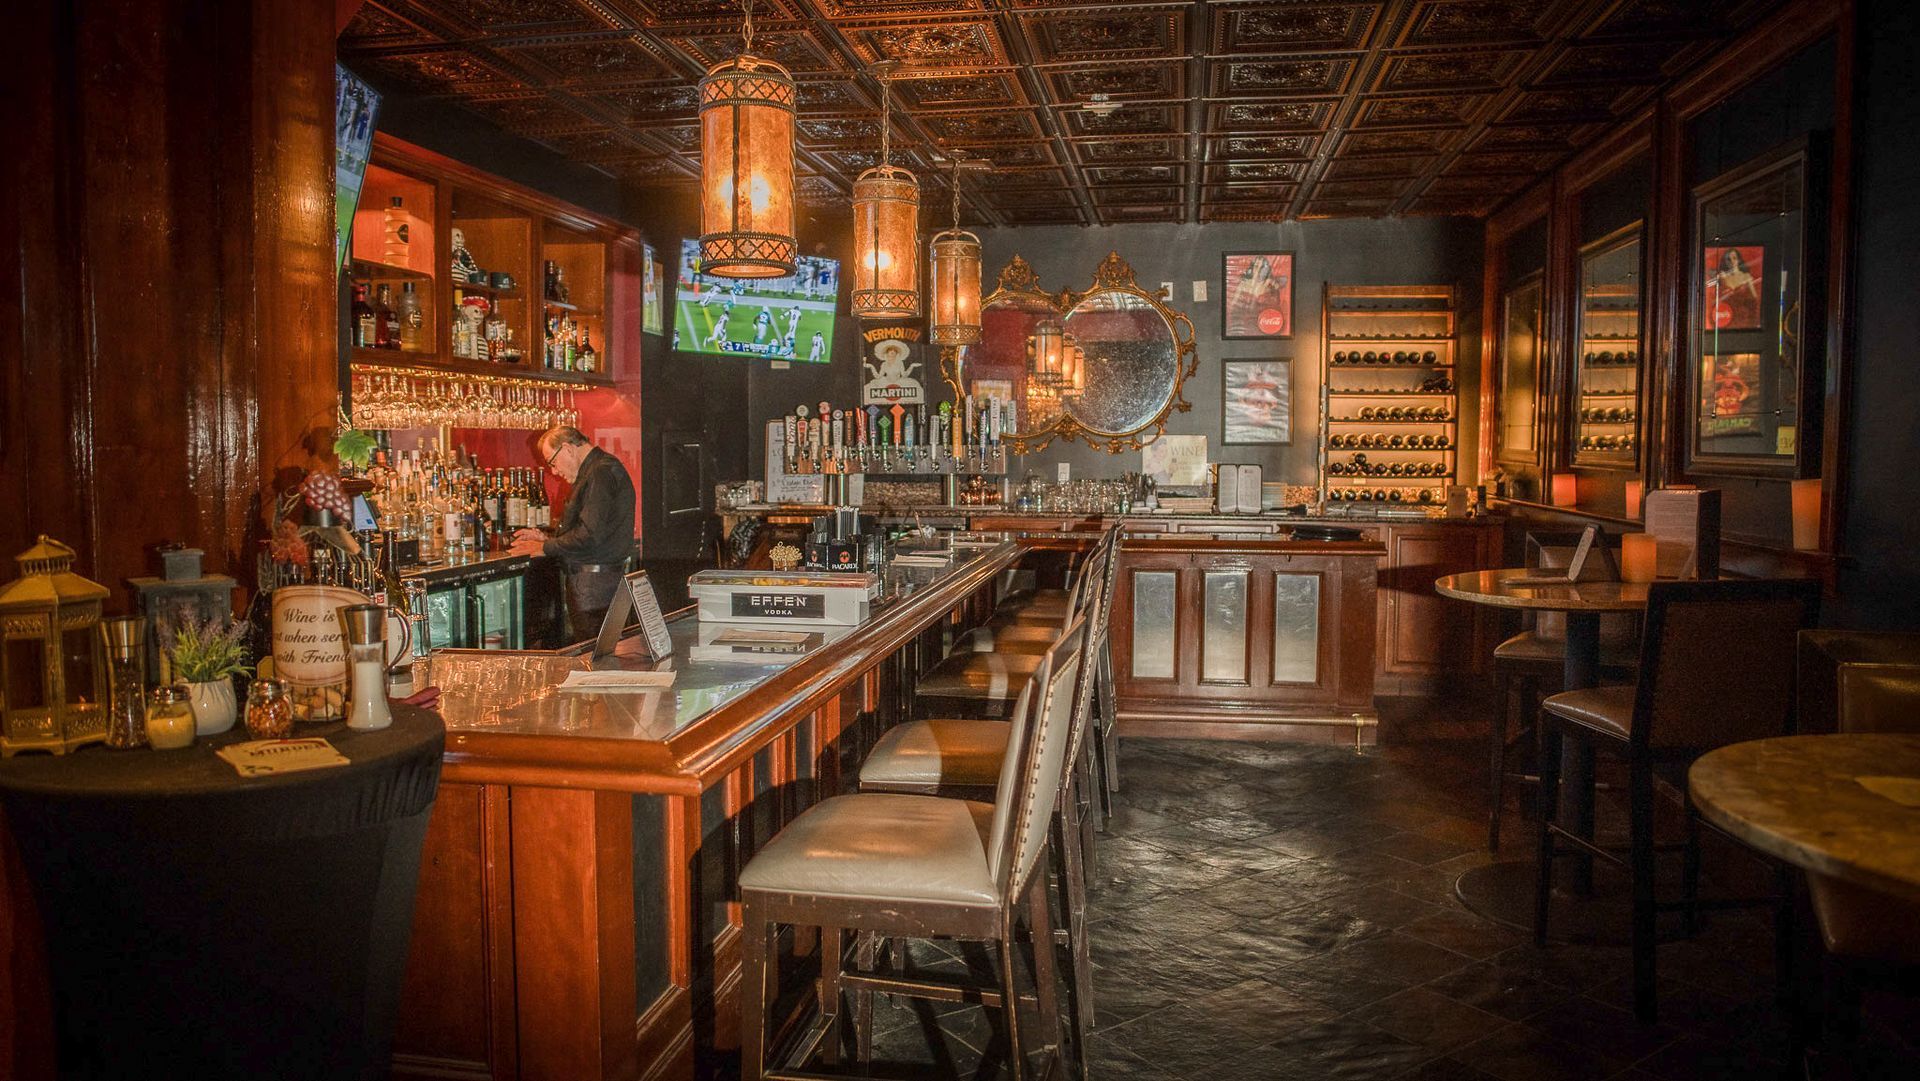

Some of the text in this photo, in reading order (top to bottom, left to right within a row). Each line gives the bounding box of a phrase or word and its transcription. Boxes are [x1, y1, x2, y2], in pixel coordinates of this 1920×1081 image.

[863, 326, 921, 343] VERMOUTH
[871, 387, 916, 398] MARTINI
[283, 607, 336, 623] Wine is
[284, 628, 318, 643] when
